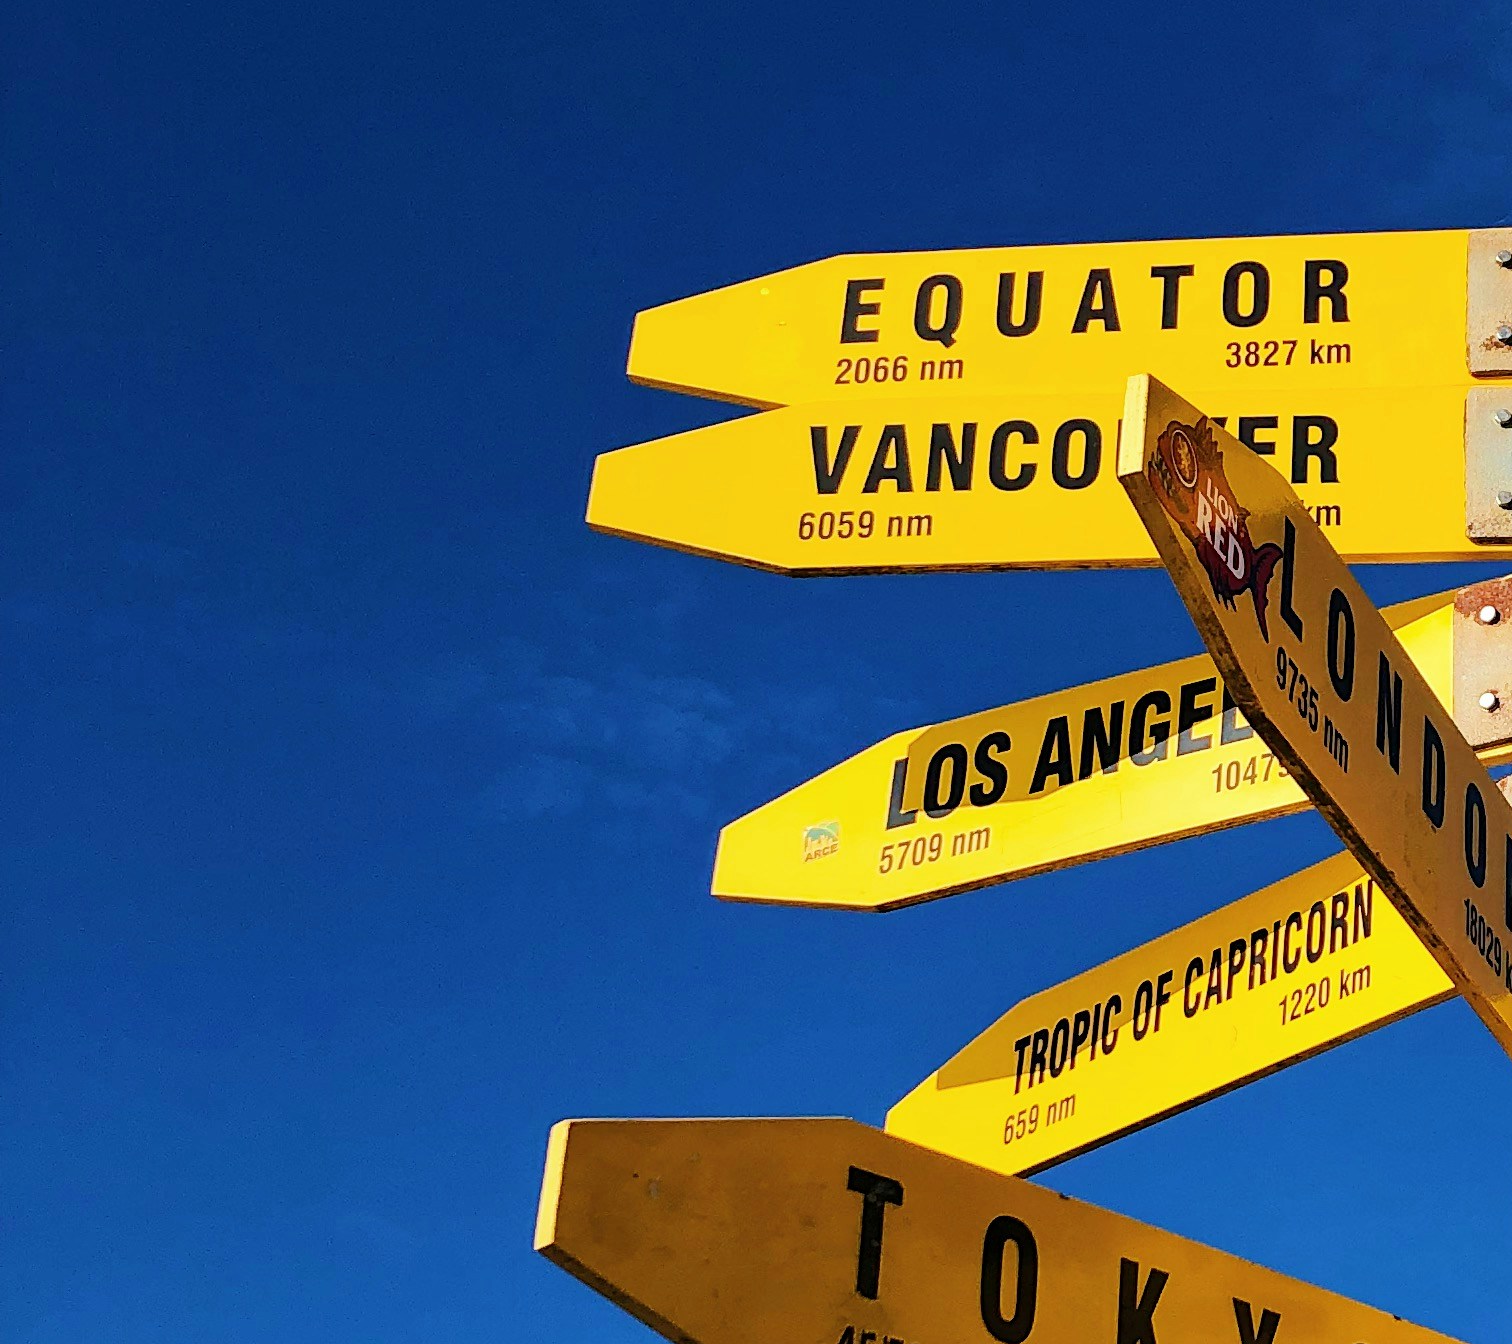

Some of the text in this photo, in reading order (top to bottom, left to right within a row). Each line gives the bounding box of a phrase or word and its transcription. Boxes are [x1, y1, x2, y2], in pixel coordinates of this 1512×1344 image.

[840, 259, 1352, 349] EQUATOR
[834, 355, 964, 385] 2066 nm
[1224, 339, 1353, 369] 3827 km
[808, 414, 1341, 496] VANCOER
[798, 510, 933, 541] 6059 nm
[1196, 491, 1245, 580] RED
[1207, 476, 1239, 534] LION
[1276, 646, 1350, 774] 9735 nm
[886, 676, 1255, 830] LOS ANGEL
[1212, 753, 1289, 793] 1047
[879, 823, 991, 875] 5709 nm
[1463, 898, 1502, 977] 18029
[1013, 879, 1375, 1096] TROPIC OF CAPRICORN
[1278, 964, 1372, 1026] 1220 km
[1003, 1092, 1076, 1145] 659 nm
